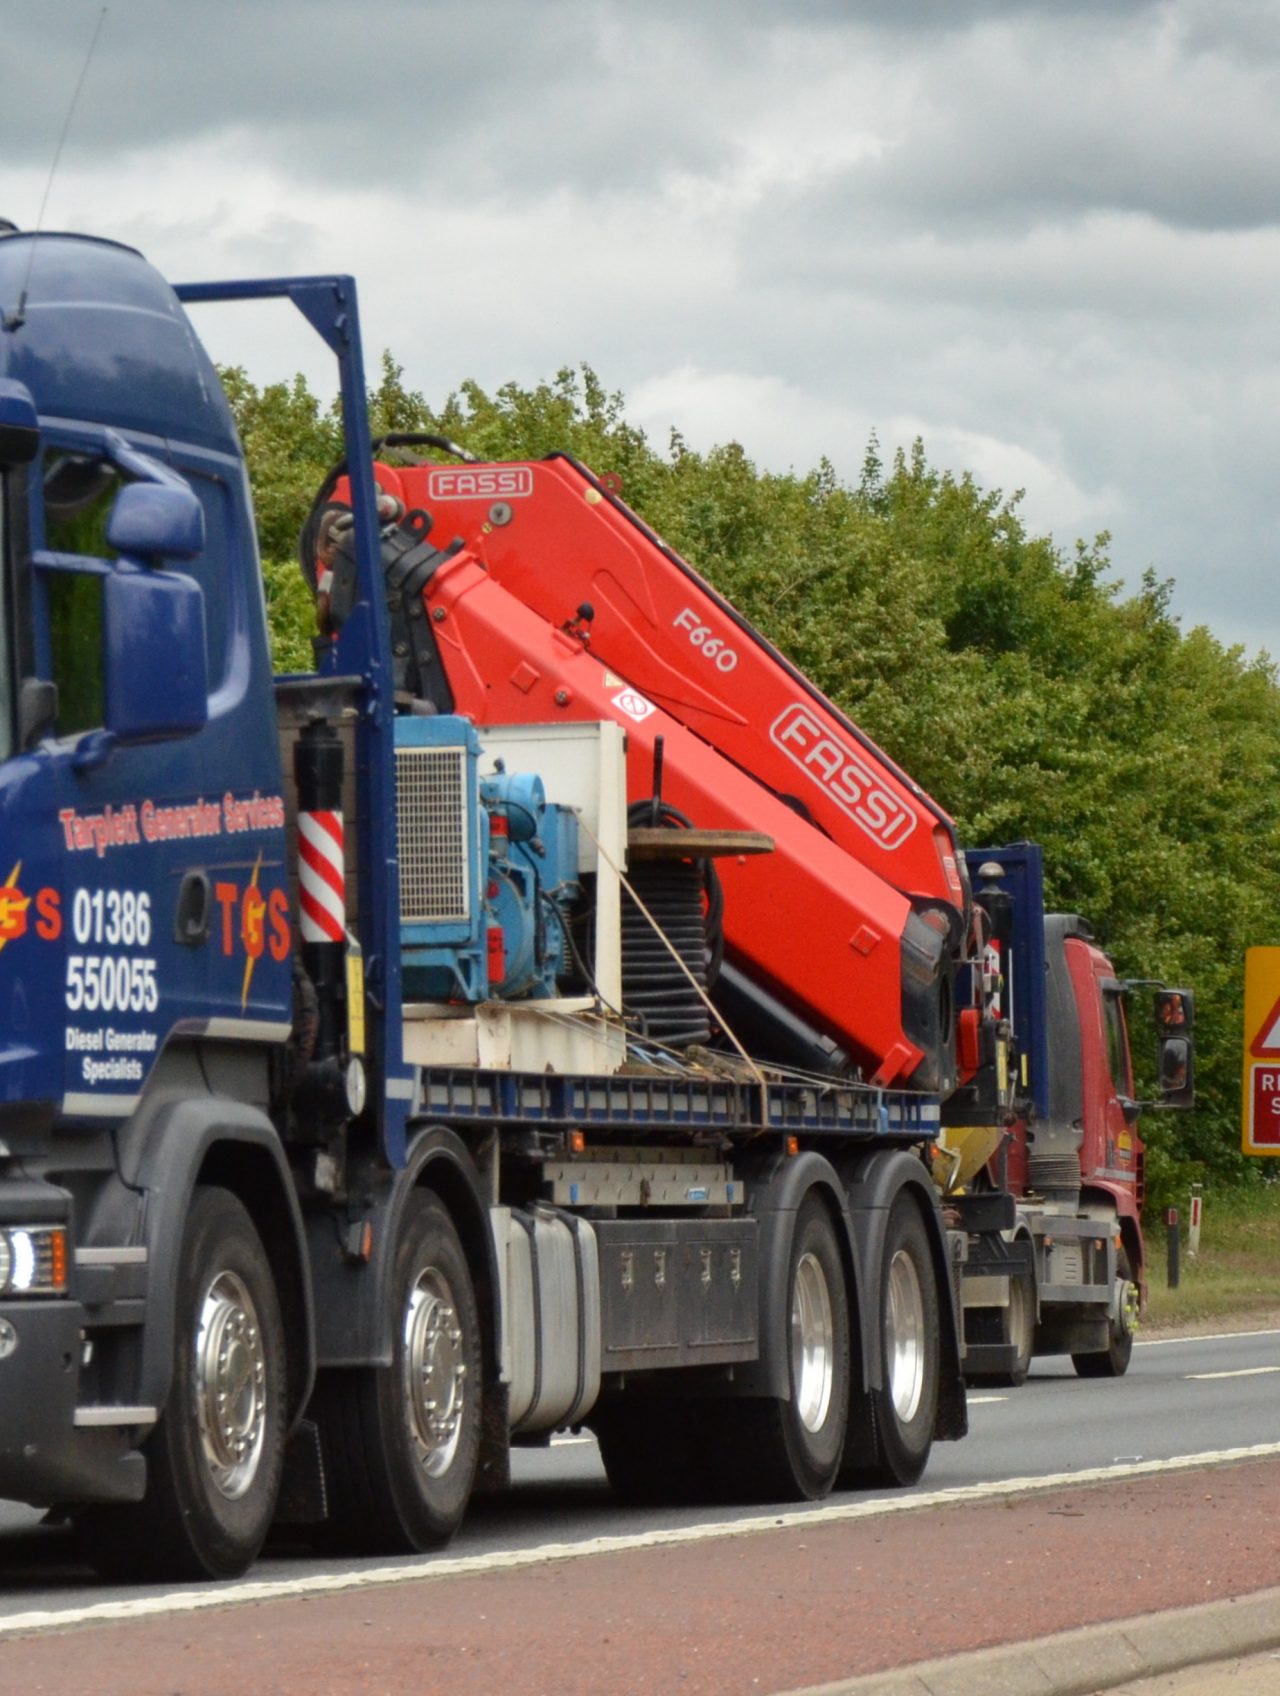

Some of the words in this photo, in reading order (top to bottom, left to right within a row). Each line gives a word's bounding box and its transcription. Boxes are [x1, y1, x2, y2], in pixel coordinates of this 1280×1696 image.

[439, 472, 524, 494] FASSI
[673, 607, 738, 673] F660
[781, 715, 907, 840] FASSI
[59, 804, 140, 858] Tarplett
[141, 799, 221, 842] Generator
[222, 791, 285, 834] Services
[73, 888, 151, 945] 01386
[216, 882, 291, 962] TGS
[65, 956, 159, 1012] 550055
[65, 1026, 103, 1051] Diesel
[105, 1027, 157, 1051] Generator
[82, 1056, 143, 1085] Specialists
